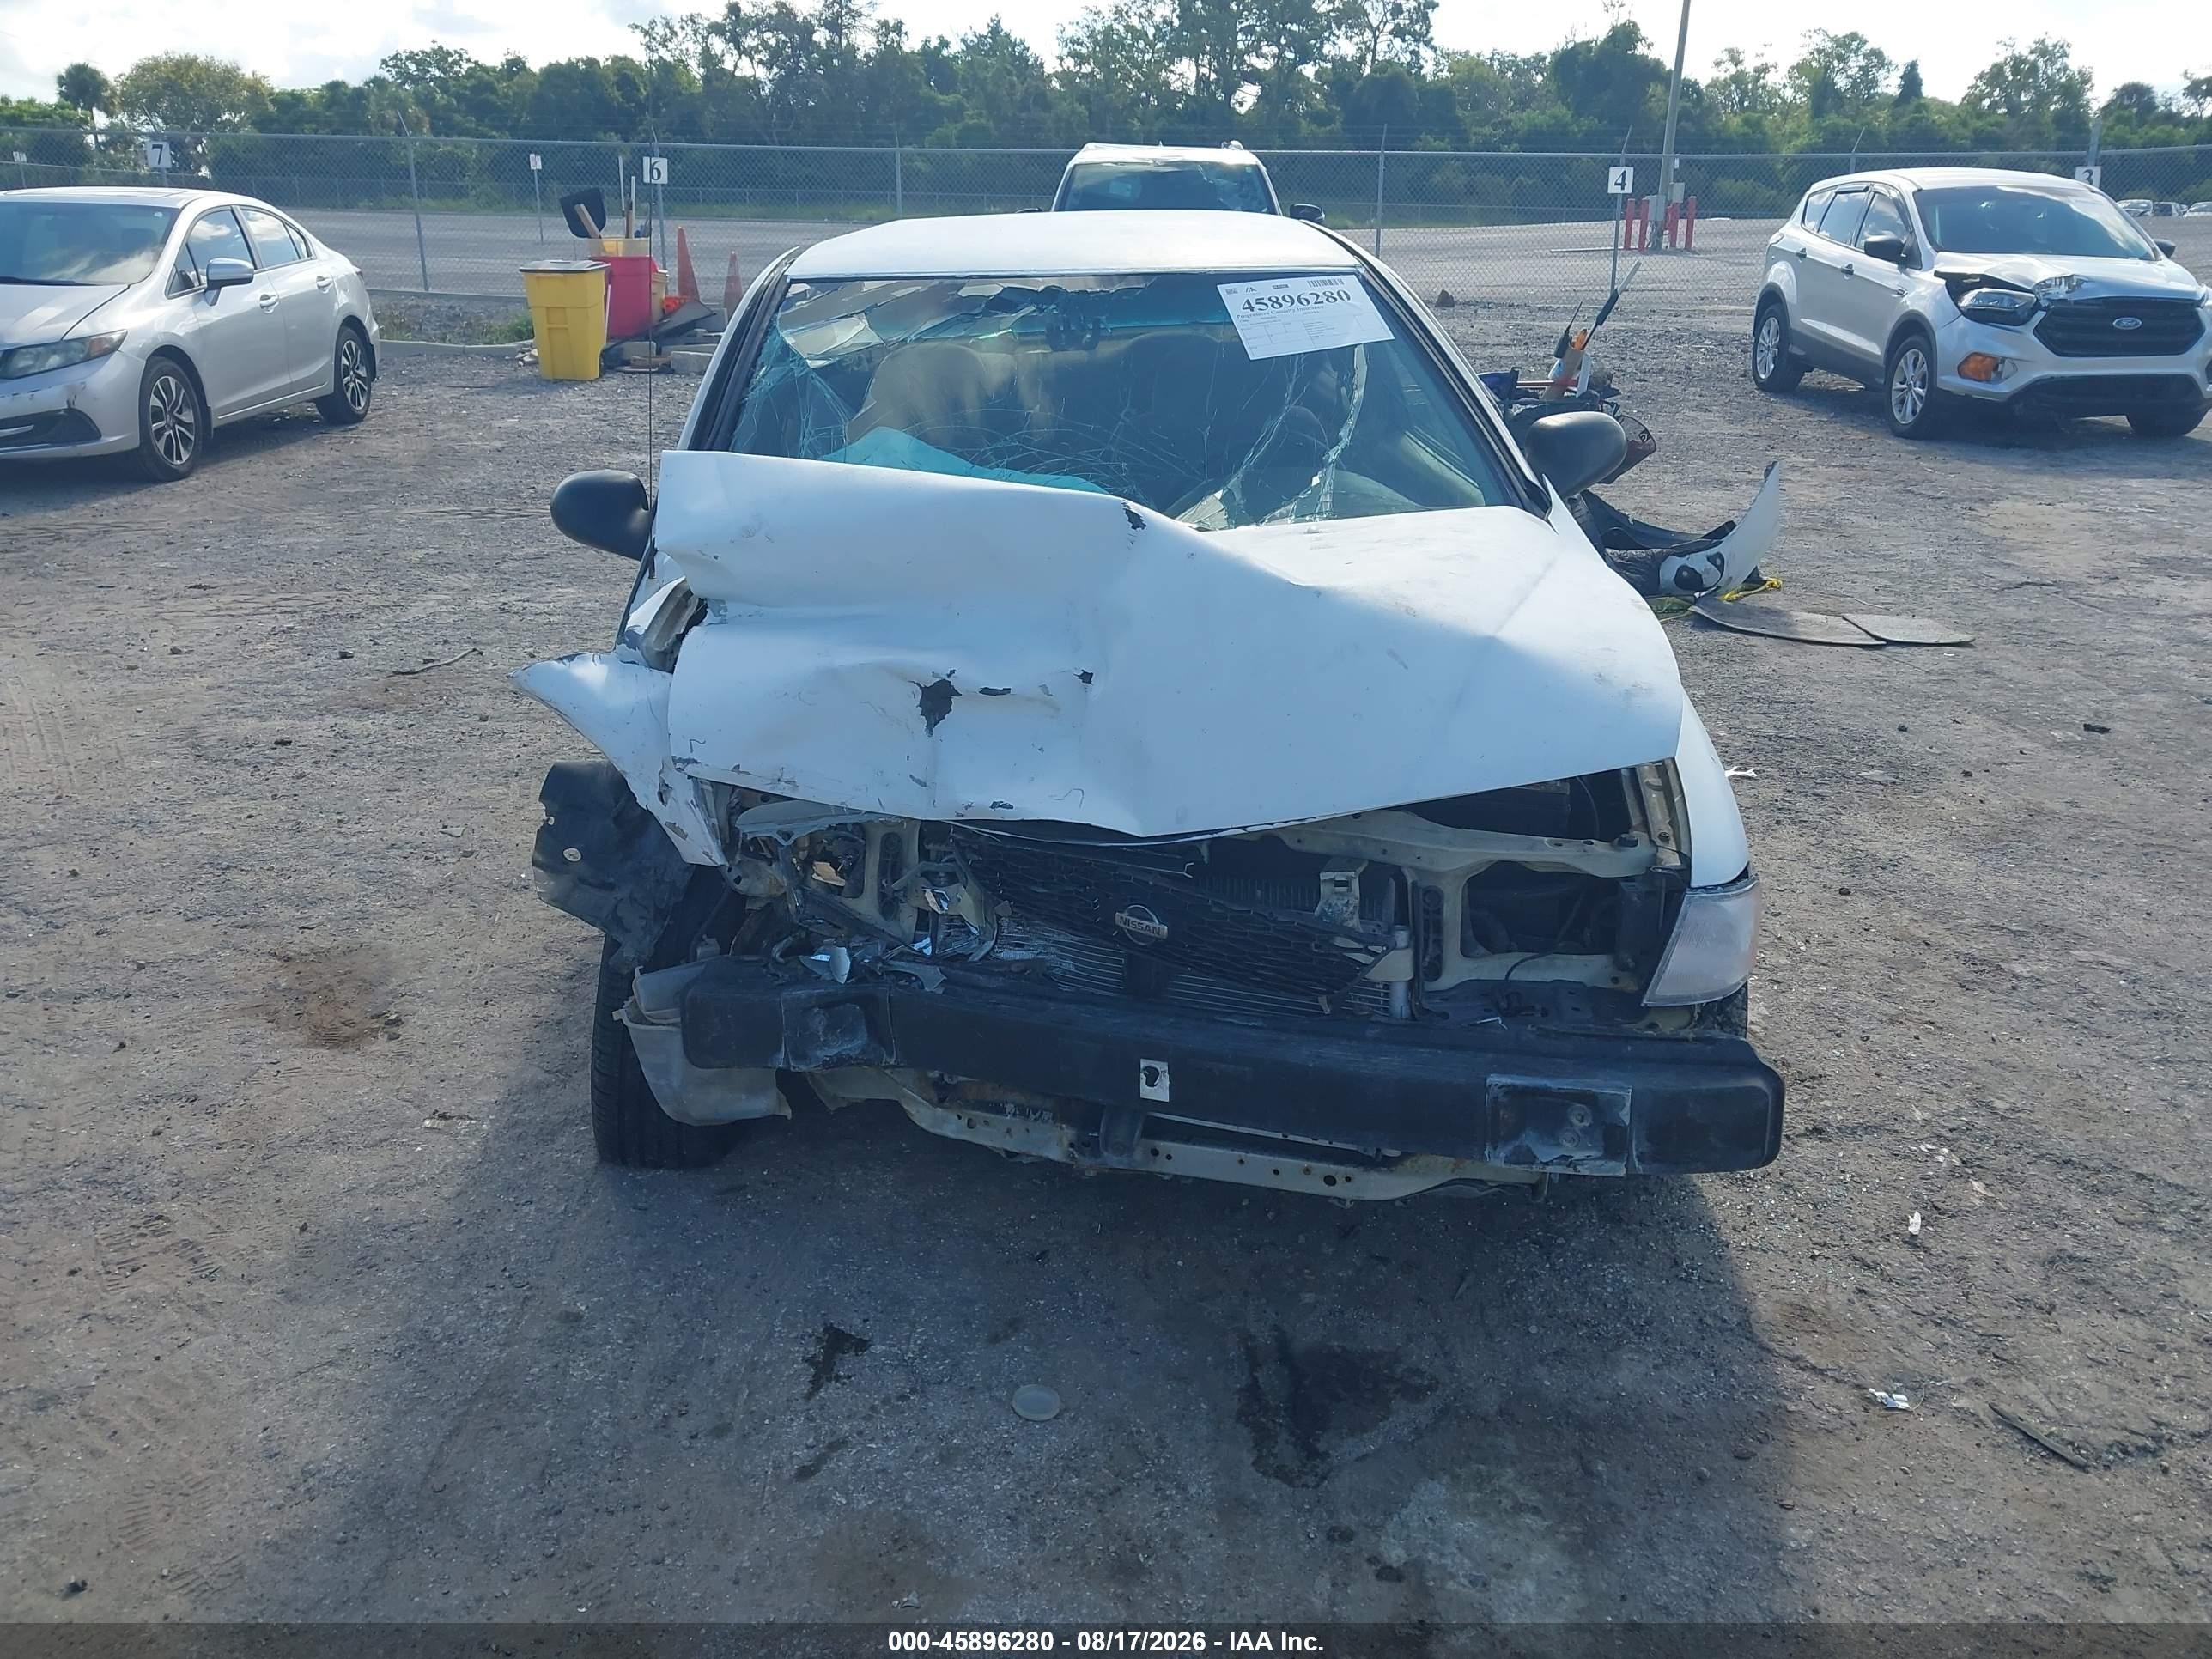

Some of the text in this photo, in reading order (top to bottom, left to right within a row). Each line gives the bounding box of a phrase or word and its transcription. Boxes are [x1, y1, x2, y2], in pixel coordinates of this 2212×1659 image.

[151, 143, 163, 166] 7
[651, 160, 662, 181] 6
[1613, 169, 1627, 191] 4
[1242, 289, 1351, 312] 45896280
[1119, 915, 1161, 936] NISSAN
